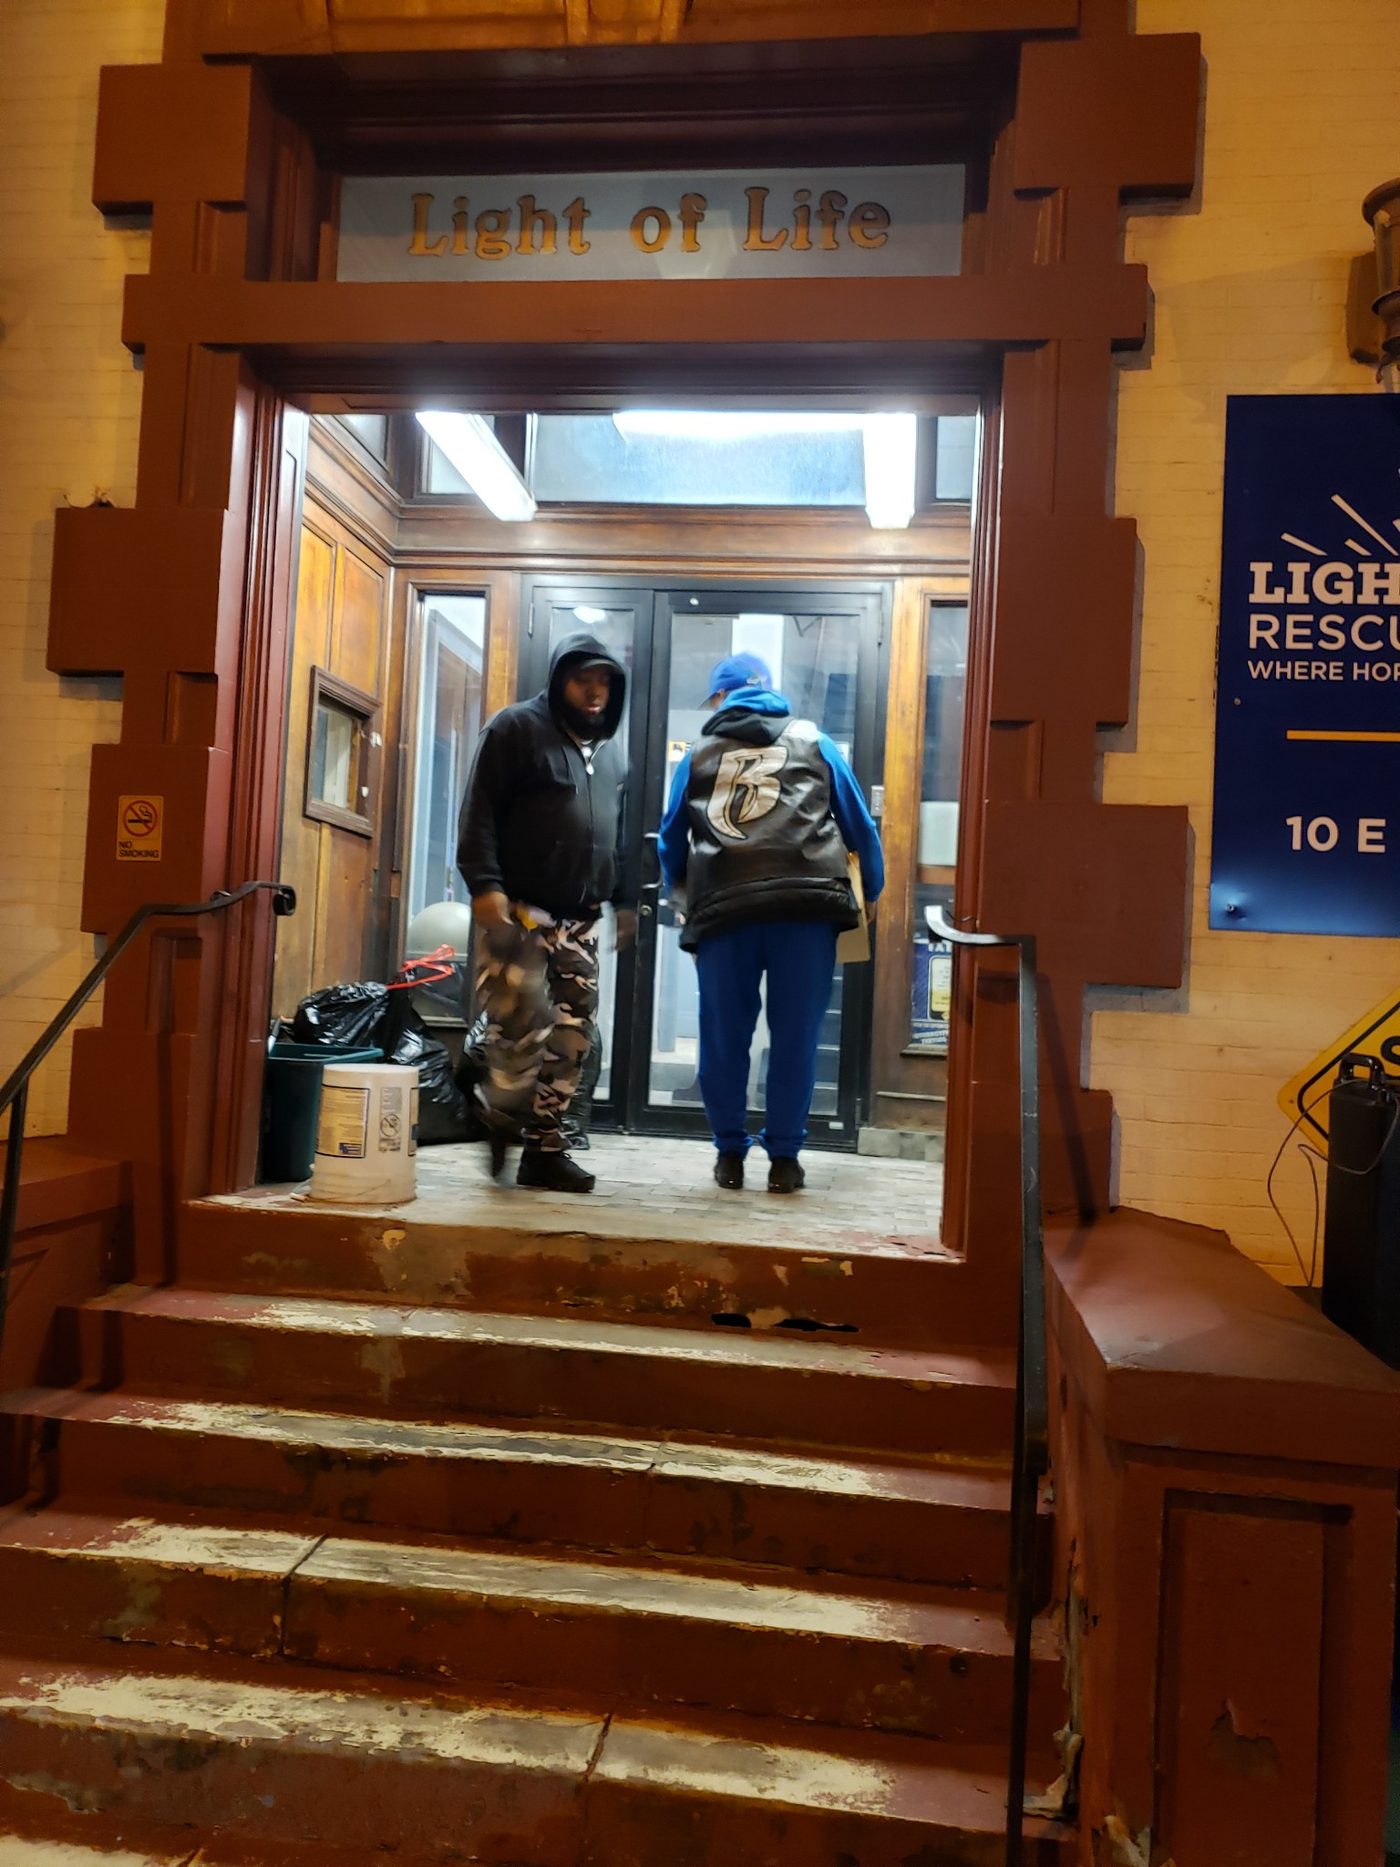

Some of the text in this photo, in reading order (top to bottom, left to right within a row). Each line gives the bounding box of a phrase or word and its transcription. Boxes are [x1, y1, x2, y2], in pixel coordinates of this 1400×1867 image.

[408, 186, 891, 260] Light of Life
[1248, 561, 1400, 605] LIGH
[1247, 660, 1344, 680] WHERE
[119, 841, 133, 849] NO
[1286, 816, 1386, 853] 10 E
[119, 849, 159, 858] SMOKING
